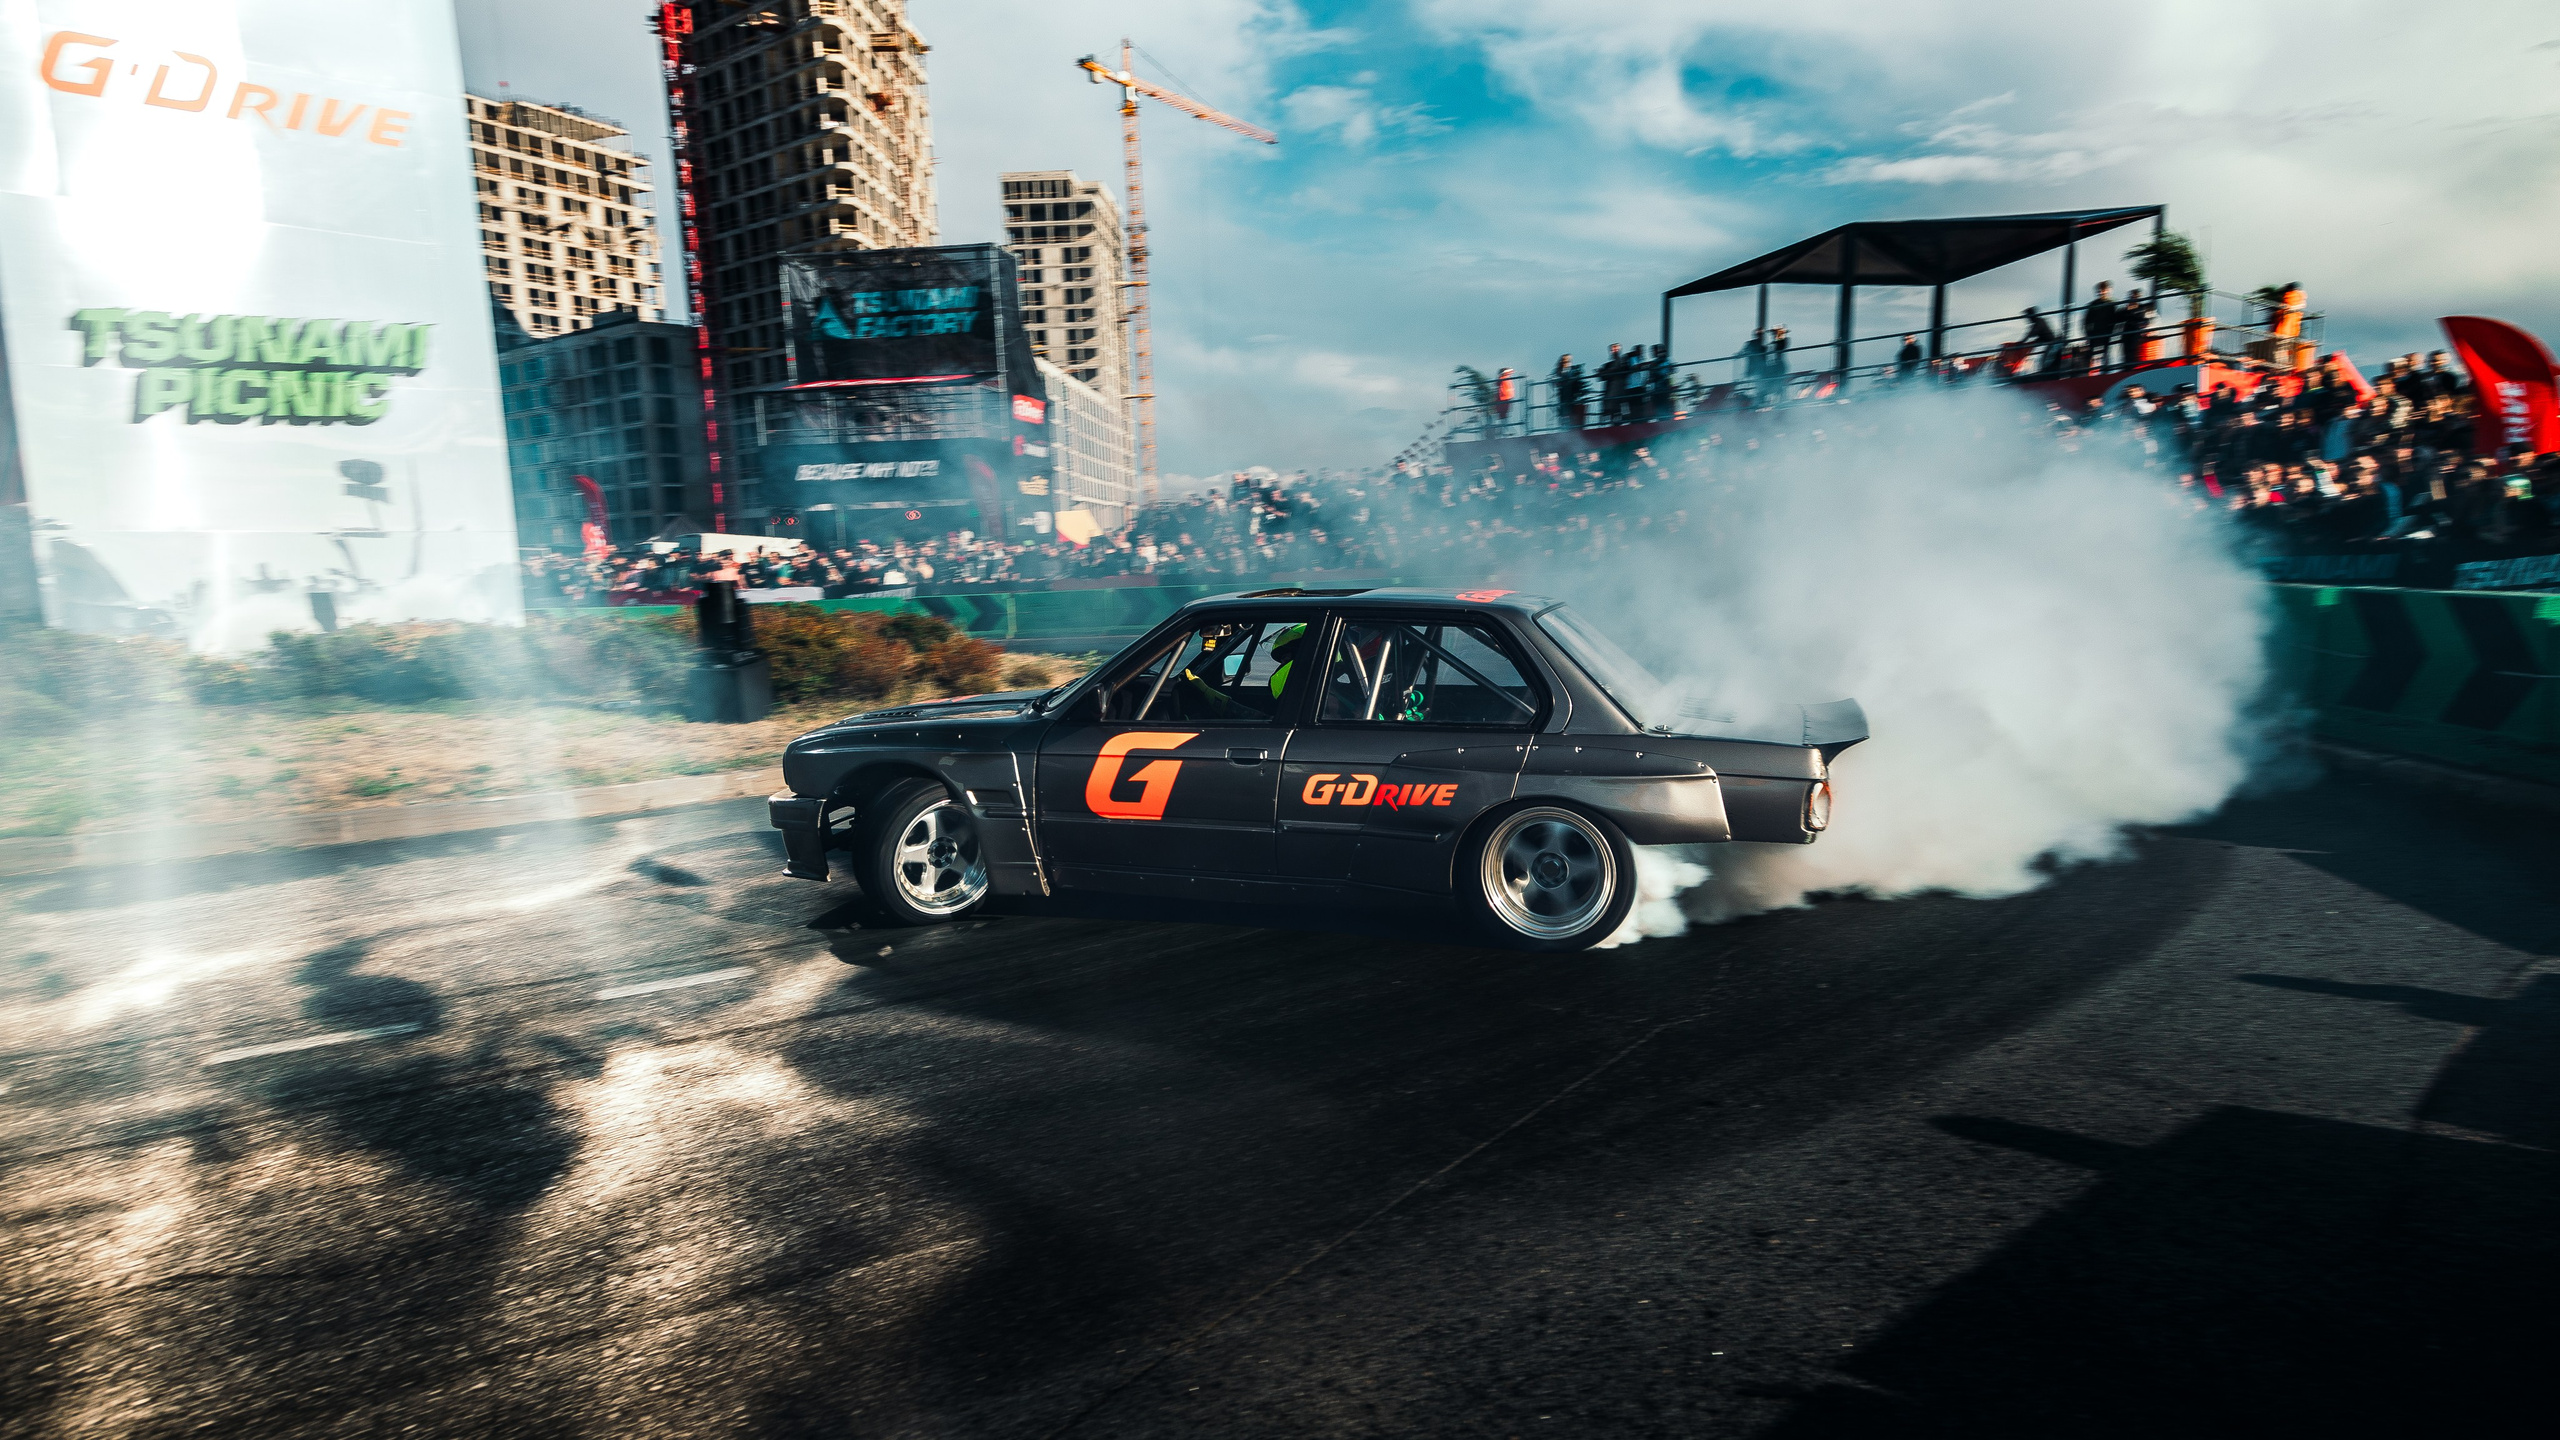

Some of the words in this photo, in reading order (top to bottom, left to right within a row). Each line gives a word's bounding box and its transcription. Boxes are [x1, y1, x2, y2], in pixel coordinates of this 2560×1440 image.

[70, 307, 437, 374] TSUNAMI
[855, 311, 979, 338] FACTORY
[131, 367, 392, 425] PICNIC
[1085, 731, 1200, 821] G
